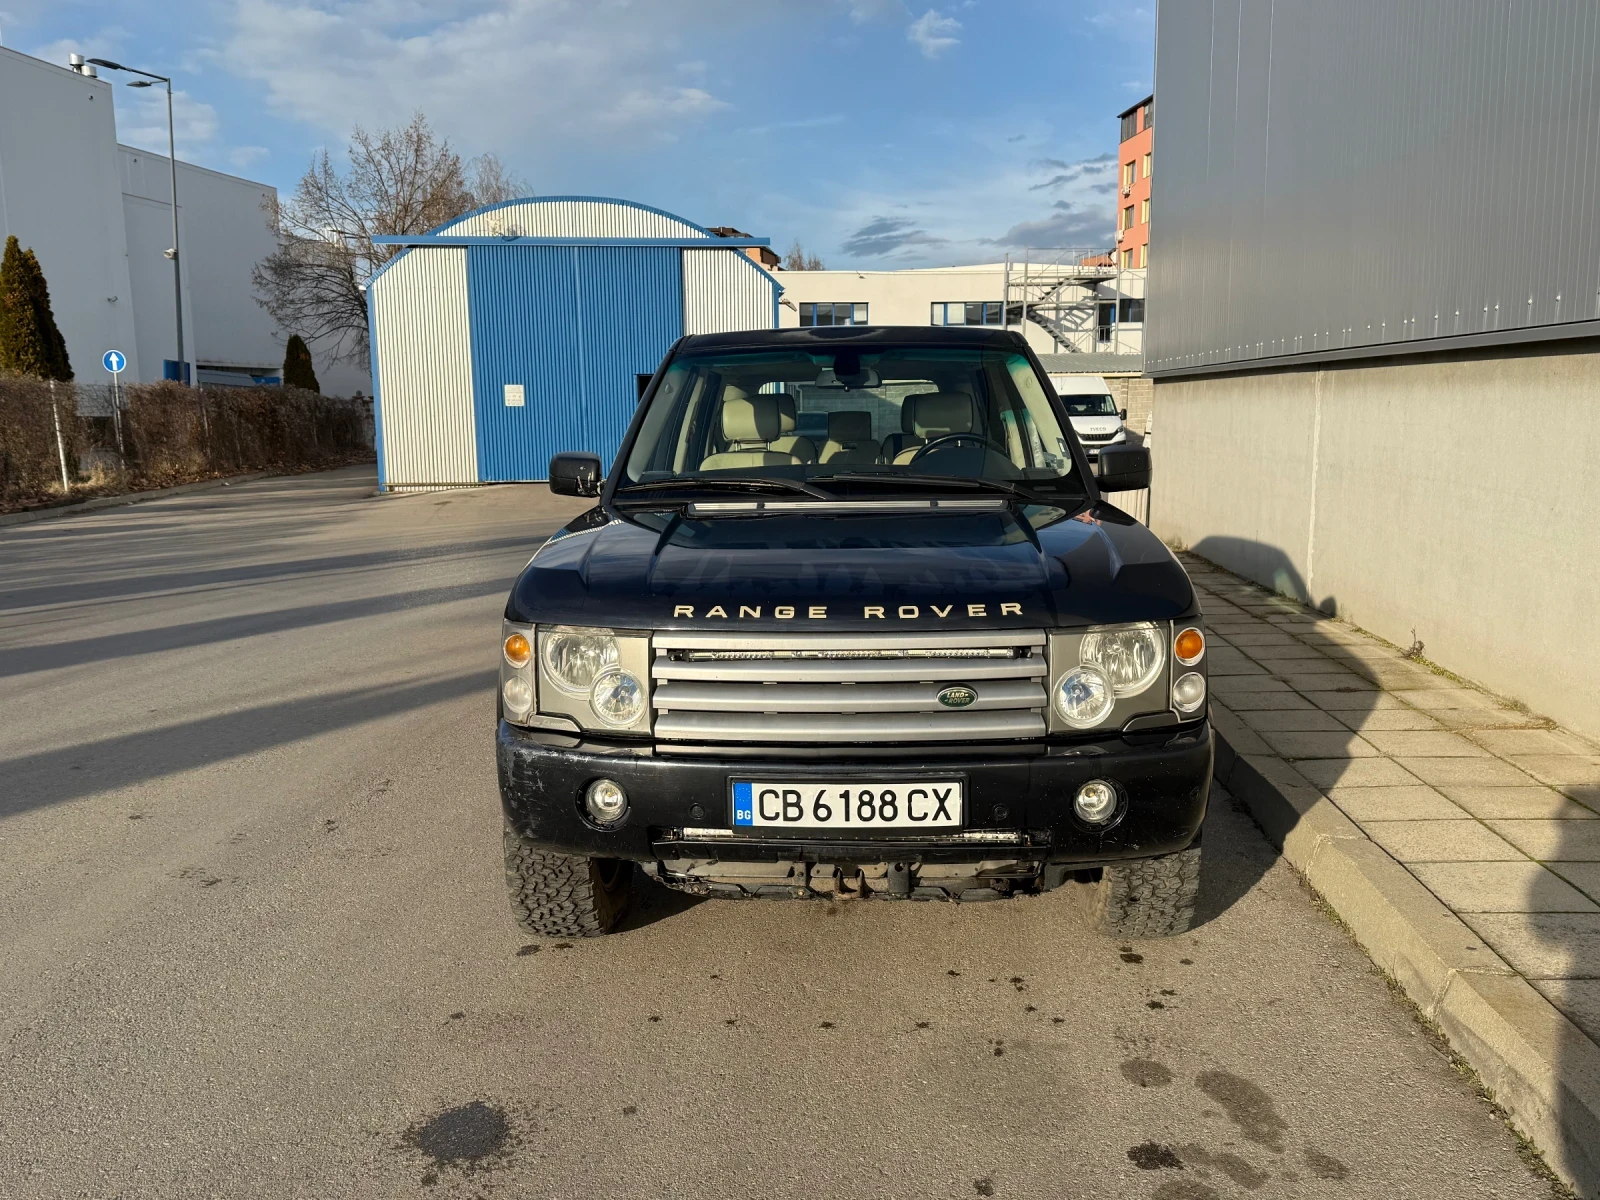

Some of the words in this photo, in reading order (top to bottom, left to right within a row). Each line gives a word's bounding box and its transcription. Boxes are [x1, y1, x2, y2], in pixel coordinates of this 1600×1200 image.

[673, 605, 828, 619] RANGE
[864, 602, 1024, 619] ROVER
[758, 789, 804, 822] CB
[812, 789, 899, 822] 6188
[907, 788, 953, 822] CX
[736, 810, 752, 820] BG
